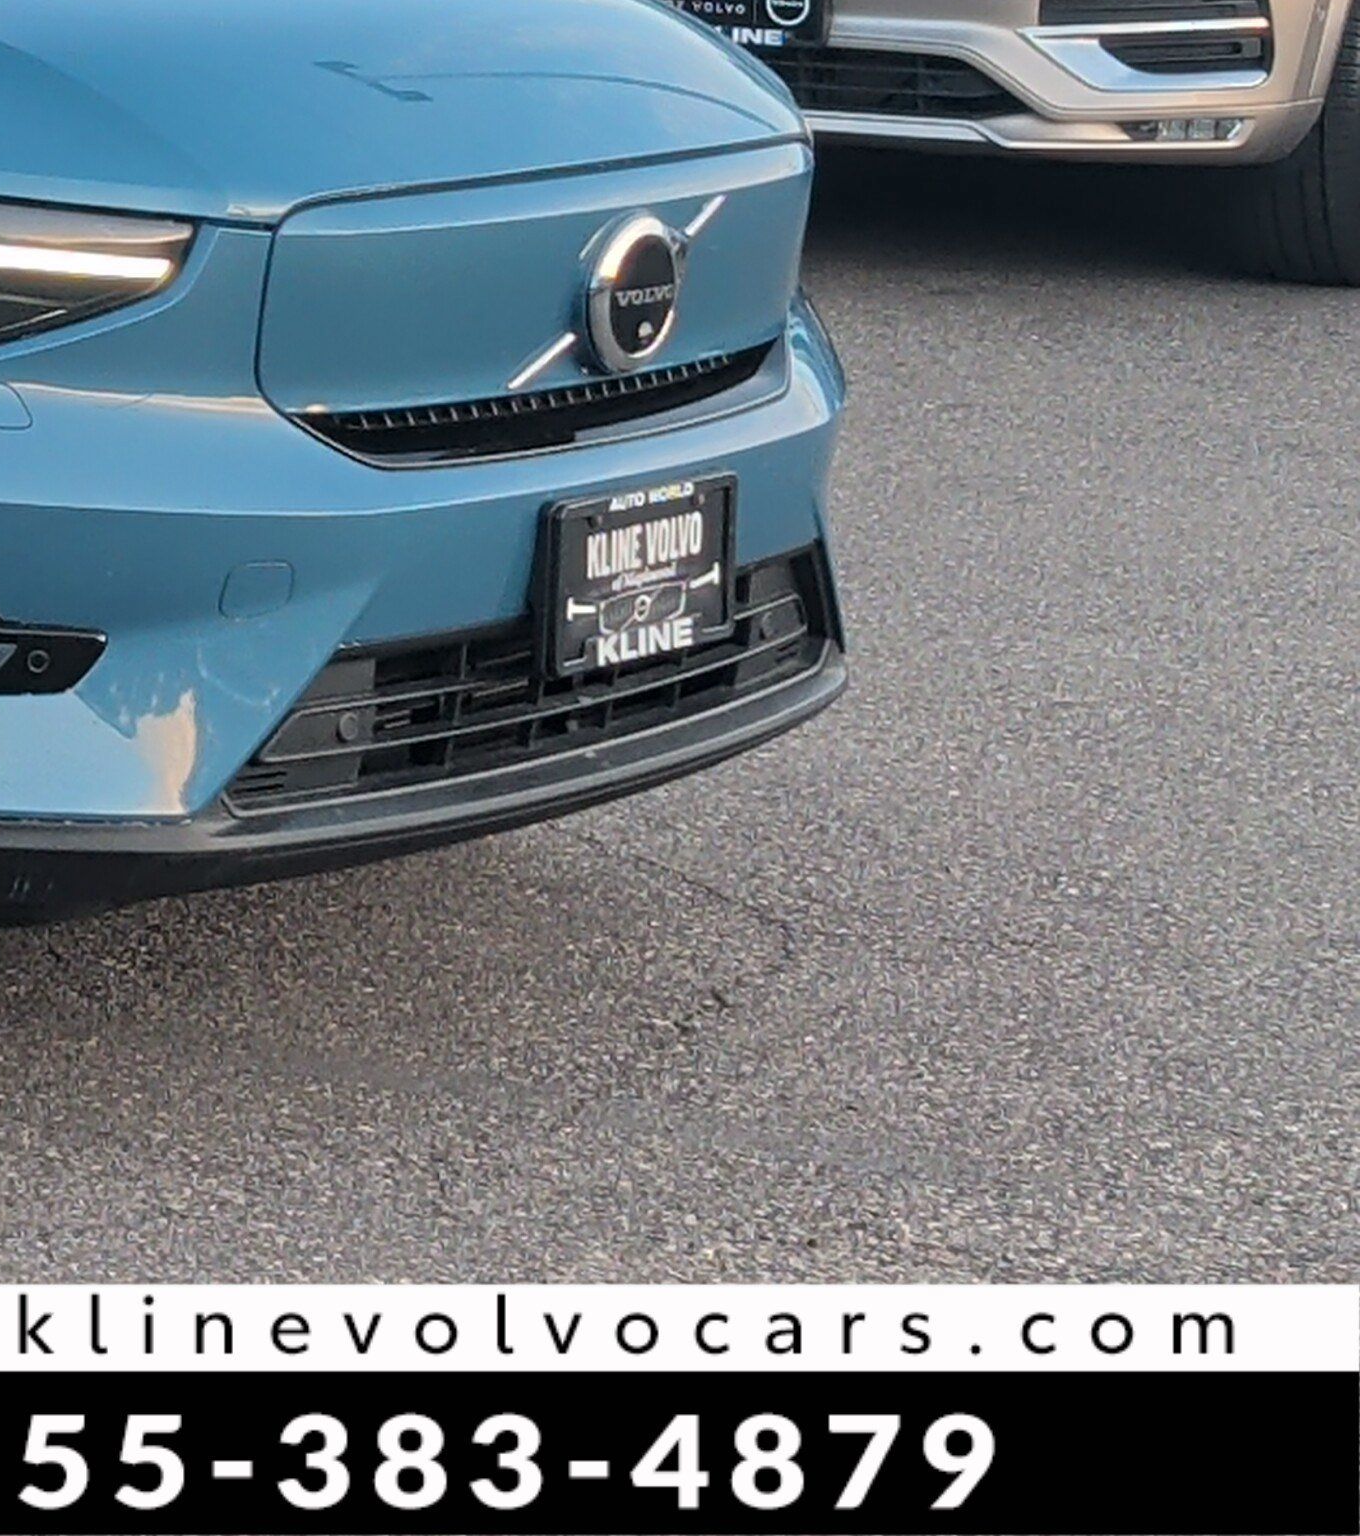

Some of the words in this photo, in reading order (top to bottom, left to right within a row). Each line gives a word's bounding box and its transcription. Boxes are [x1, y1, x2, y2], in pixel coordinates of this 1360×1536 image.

[692, 1, 746, 15] VOLVO
[615, 284, 674, 307] VOLVO
[609, 491, 646, 512] AUTO
[648, 481, 695, 504] WORLD
[587, 524, 643, 580] KLINE
[645, 510, 703, 565] VOLVO
[597, 616, 693, 667] KLINE
